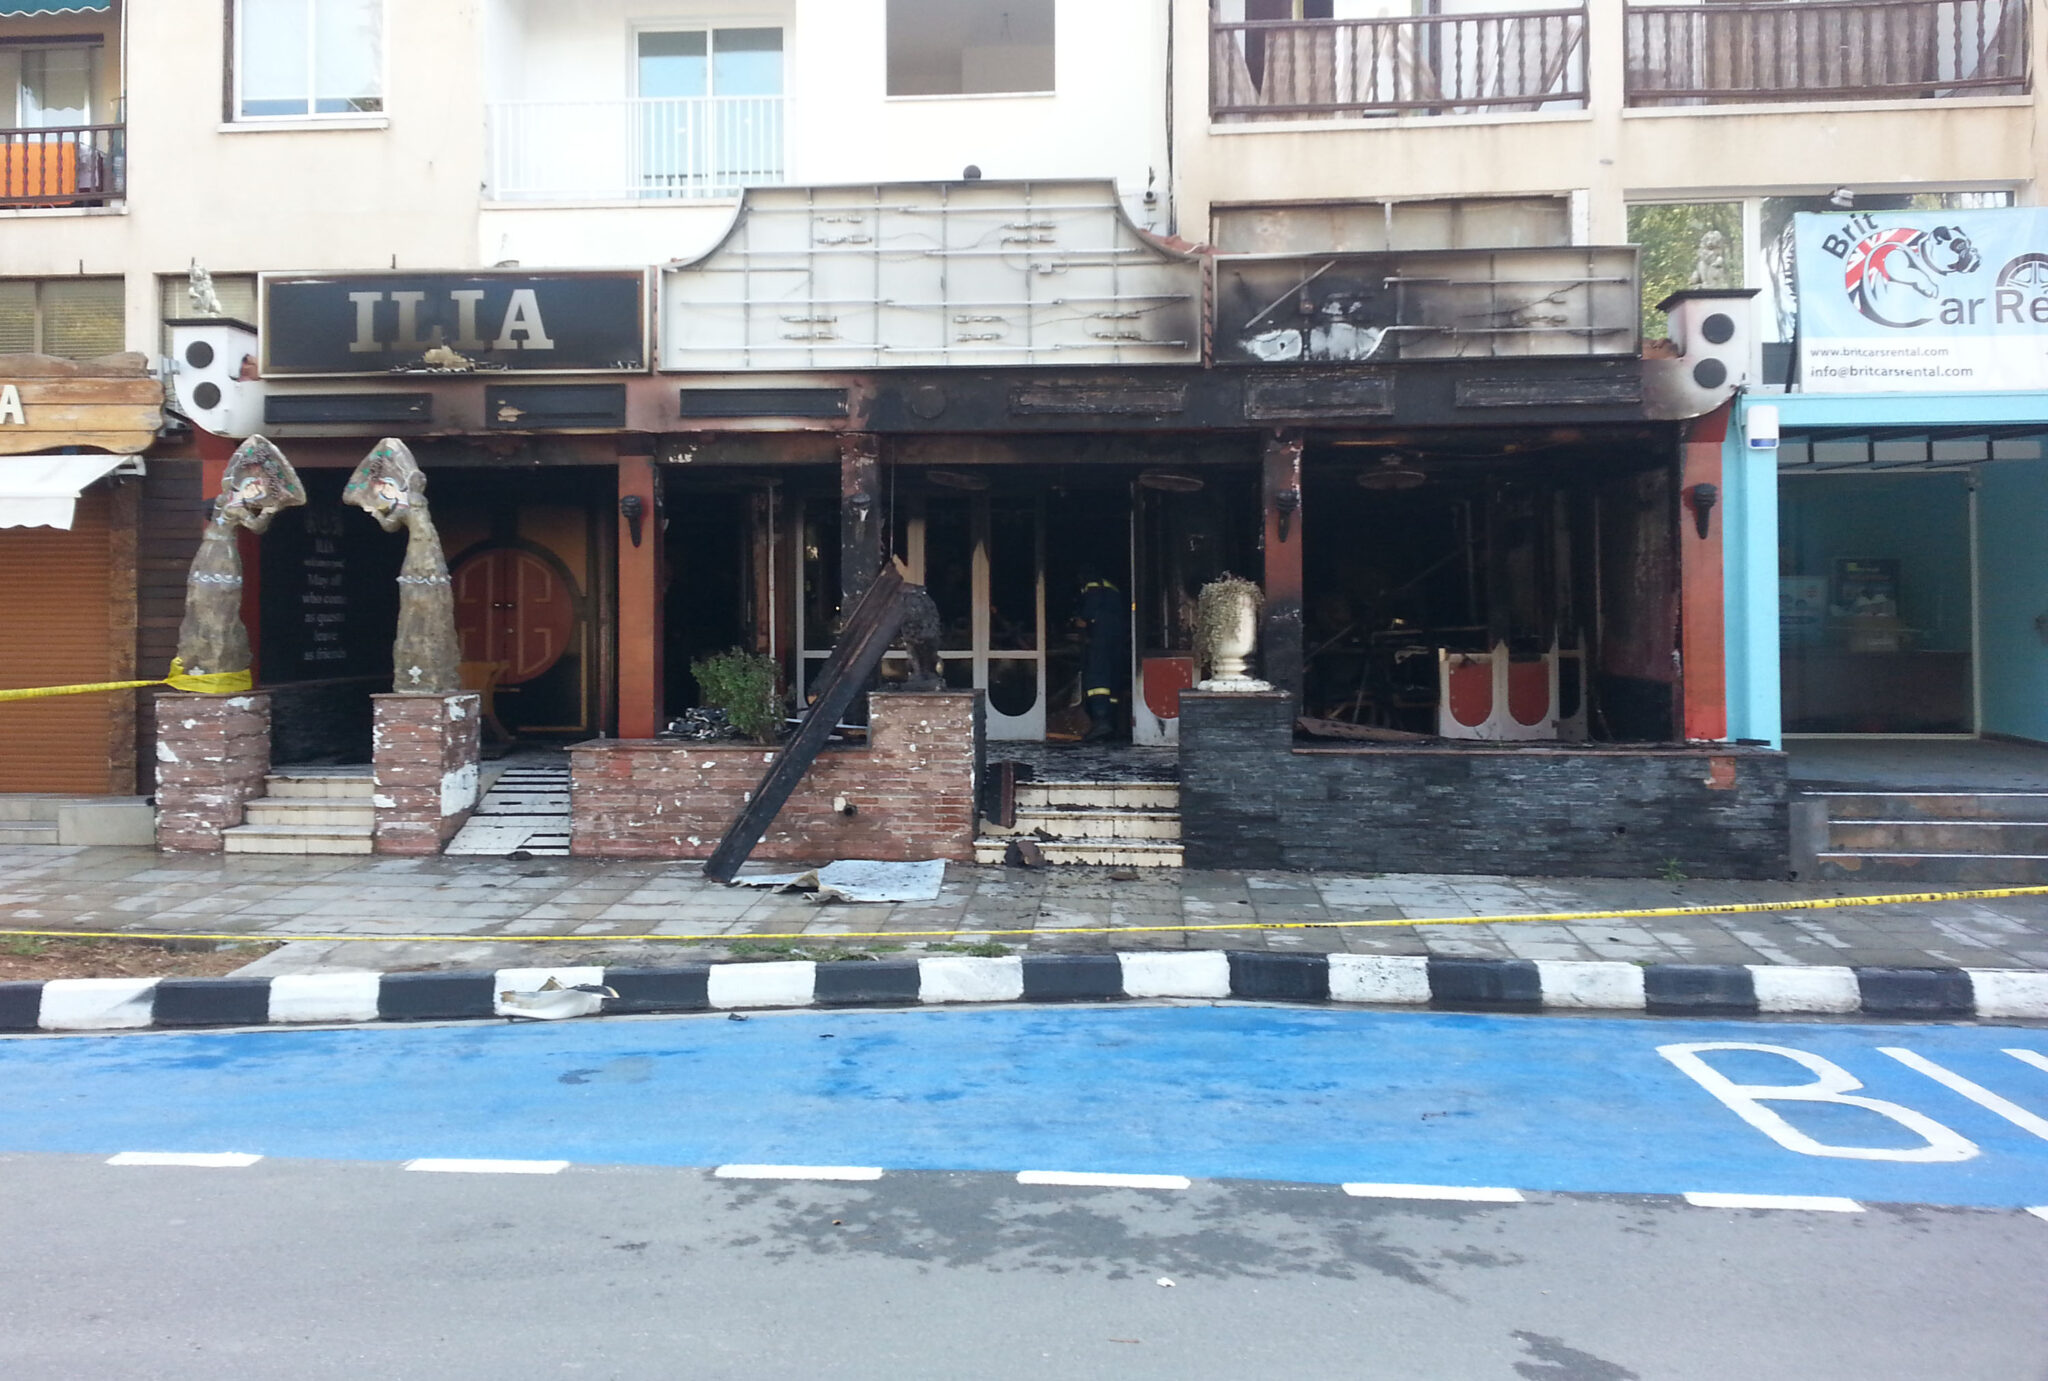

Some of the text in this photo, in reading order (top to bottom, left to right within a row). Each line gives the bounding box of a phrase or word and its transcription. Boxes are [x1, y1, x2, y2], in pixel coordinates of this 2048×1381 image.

[1822, 212, 1879, 260] Brit
[349, 289, 554, 352] ILIA
[1810, 346, 1949, 358] www.britcarsrental.com
[1810, 366, 1973, 379] info@britcarsrental.com
[302, 592, 322, 604] who
